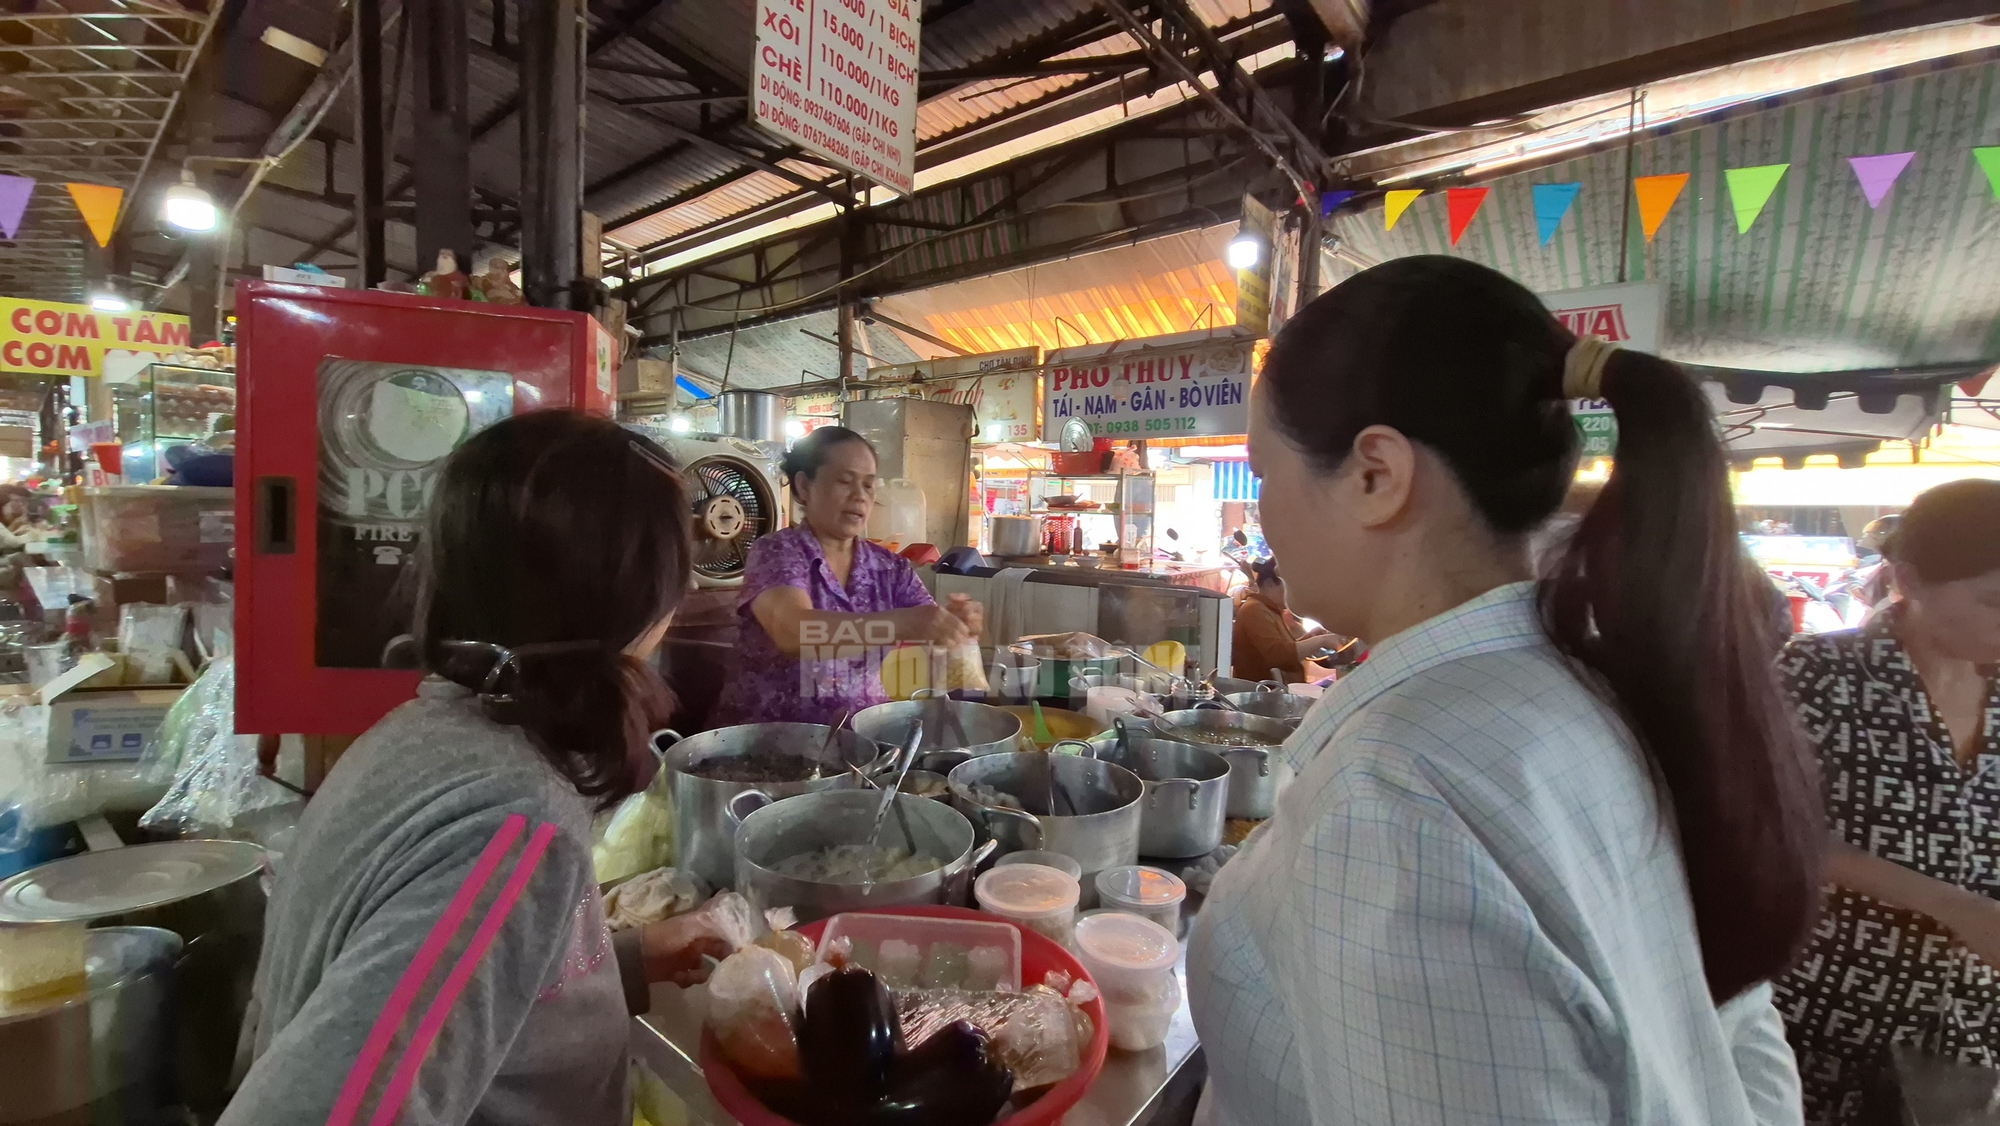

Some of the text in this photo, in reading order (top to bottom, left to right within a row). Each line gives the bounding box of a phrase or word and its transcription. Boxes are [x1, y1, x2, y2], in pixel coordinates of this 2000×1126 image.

[763, 6, 800, 46] XÔI
[889, 22, 915, 56] BỊCH
[822, 9, 864, 51] 15.000
[887, 54, 914, 86] BỊCH
[762, 45, 802, 83] CHÈ
[760, 73, 770, 93] DI
[759, 100, 769, 119] DI
[11, 307, 190, 347] CƠM TẤM
[3, 340, 92, 371] CƠM
[1053, 393, 1072, 418] TÁI
[1084, 394, 1117, 419] NẠM
[1179, 380, 1202, 408] BÒ
[1204, 377, 1242, 407] VIÊN
[1008, 425, 1028, 436] 135
[1106, 419, 1139, 433] 0938
[1145, 417, 1171, 431] 505
[1176, 416, 1195, 430] 112
[353, 524, 414, 541] FIRE
